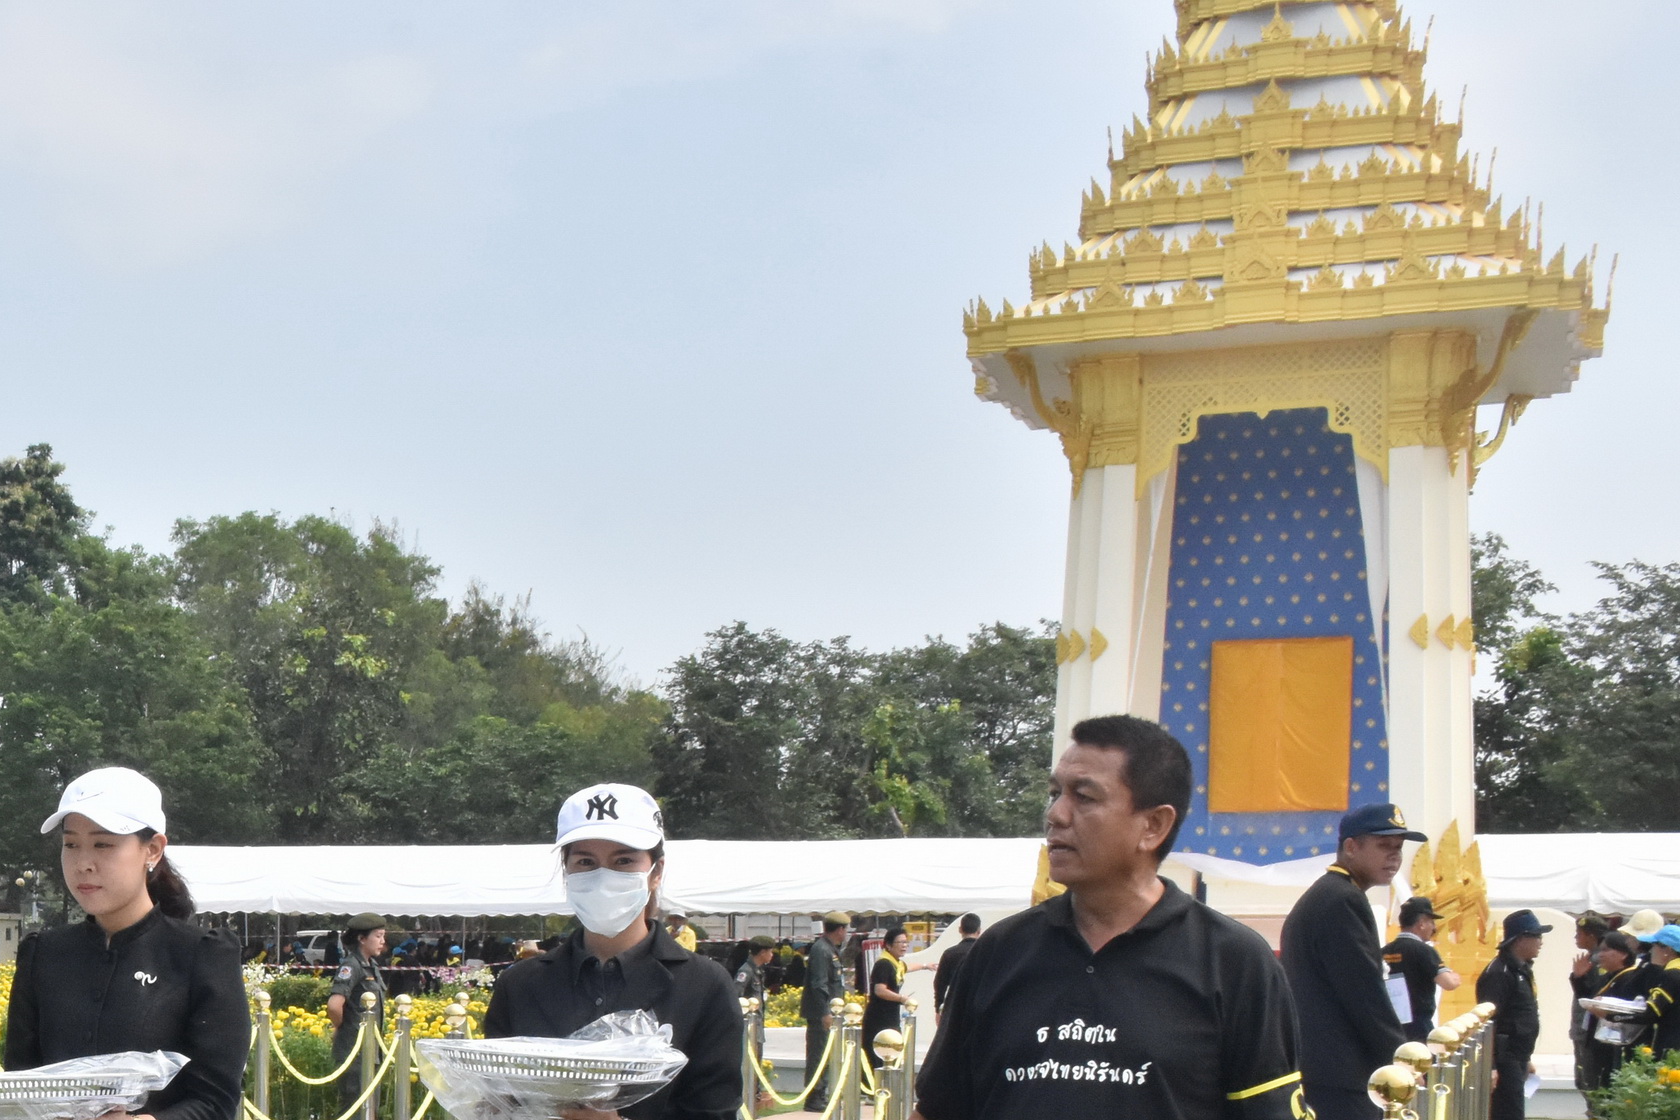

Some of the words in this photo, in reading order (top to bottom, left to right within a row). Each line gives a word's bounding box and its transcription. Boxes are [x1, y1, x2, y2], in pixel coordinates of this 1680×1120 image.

[1036, 1026, 1050, 1043] ธ
[1057, 1018, 1117, 1045] สถิตใน
